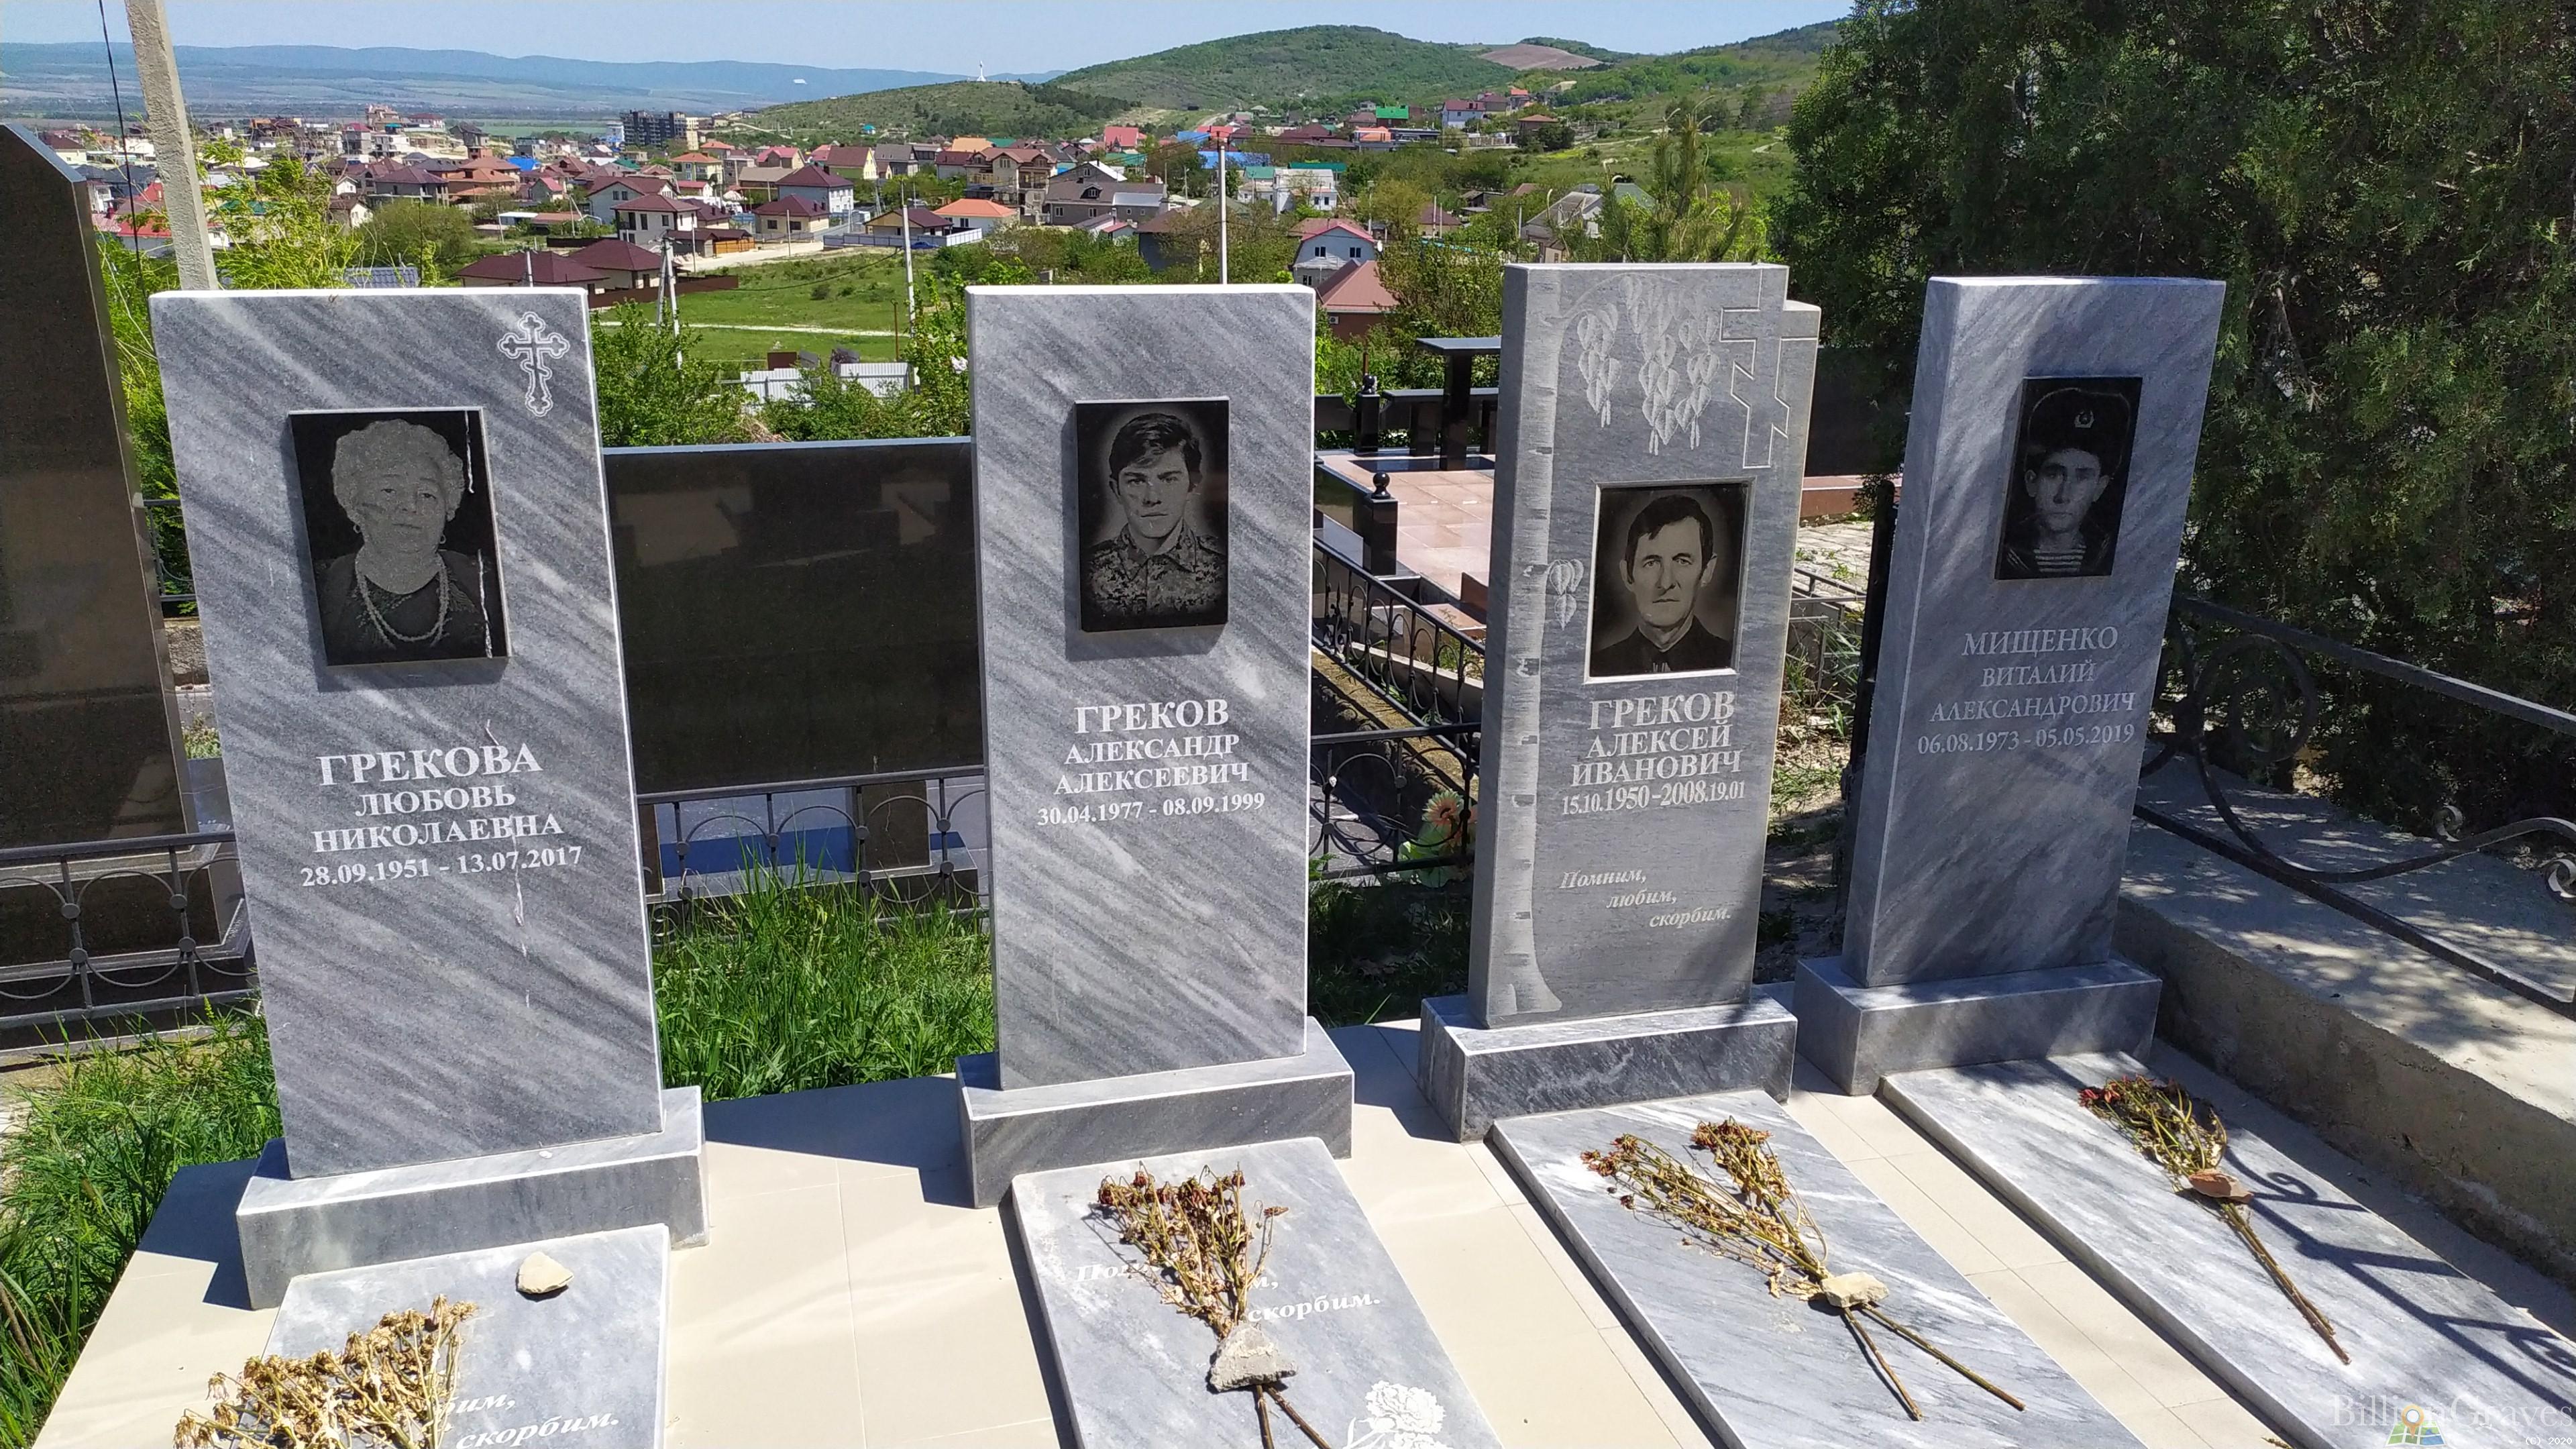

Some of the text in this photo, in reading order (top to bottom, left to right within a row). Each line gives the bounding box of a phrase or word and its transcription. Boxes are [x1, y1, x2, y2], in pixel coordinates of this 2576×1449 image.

[1962, 626, 2118, 657] МИЩЕНКО
[1980, 659, 2097, 687] ВИТАЛИЙ
[1074, 699, 1228, 734] ГРЕКОВ
[1587, 691, 1734, 730] ГРЕКОВ
[1929, 692, 2137, 722] АЛЕКСАНДРОВИЧ
[1064, 734, 1240, 765] АЛЕКСАНДР
[1585, 720, 1733, 759] АЛЕКСЕЙ
[1917, 731, 2020, 755] 06.08.1973
[2036, 723, 2135, 747] 05.05.2019
[317, 743, 543, 785] ГРЕКОВА
[1054, 762, 1250, 795] АЛЕКСЕЕВИЧ
[1570, 750, 1743, 787] ИВАНОВИЧ
[356, 785, 516, 816] ЛЮБОВЬ
[1037, 802, 1143, 826] 30.04.1977
[1163, 792, 1265, 816] 08.09.1999
[311, 813, 564, 852] НИКОЛАЕВНА
[301, 857, 431, 886] 28.09.1951
[458, 846, 582, 873] 13.07.2017
[1559, 869, 1647, 889] Помним,
[1607, 888, 1677, 908] любим,
[1650, 906, 1731, 928] скорбим.
[1247, 1290, 1381, 1324] скорбим.
[443, 1393, 516, 1413] бим,
[456, 1413, 619, 1448] скорбим.
